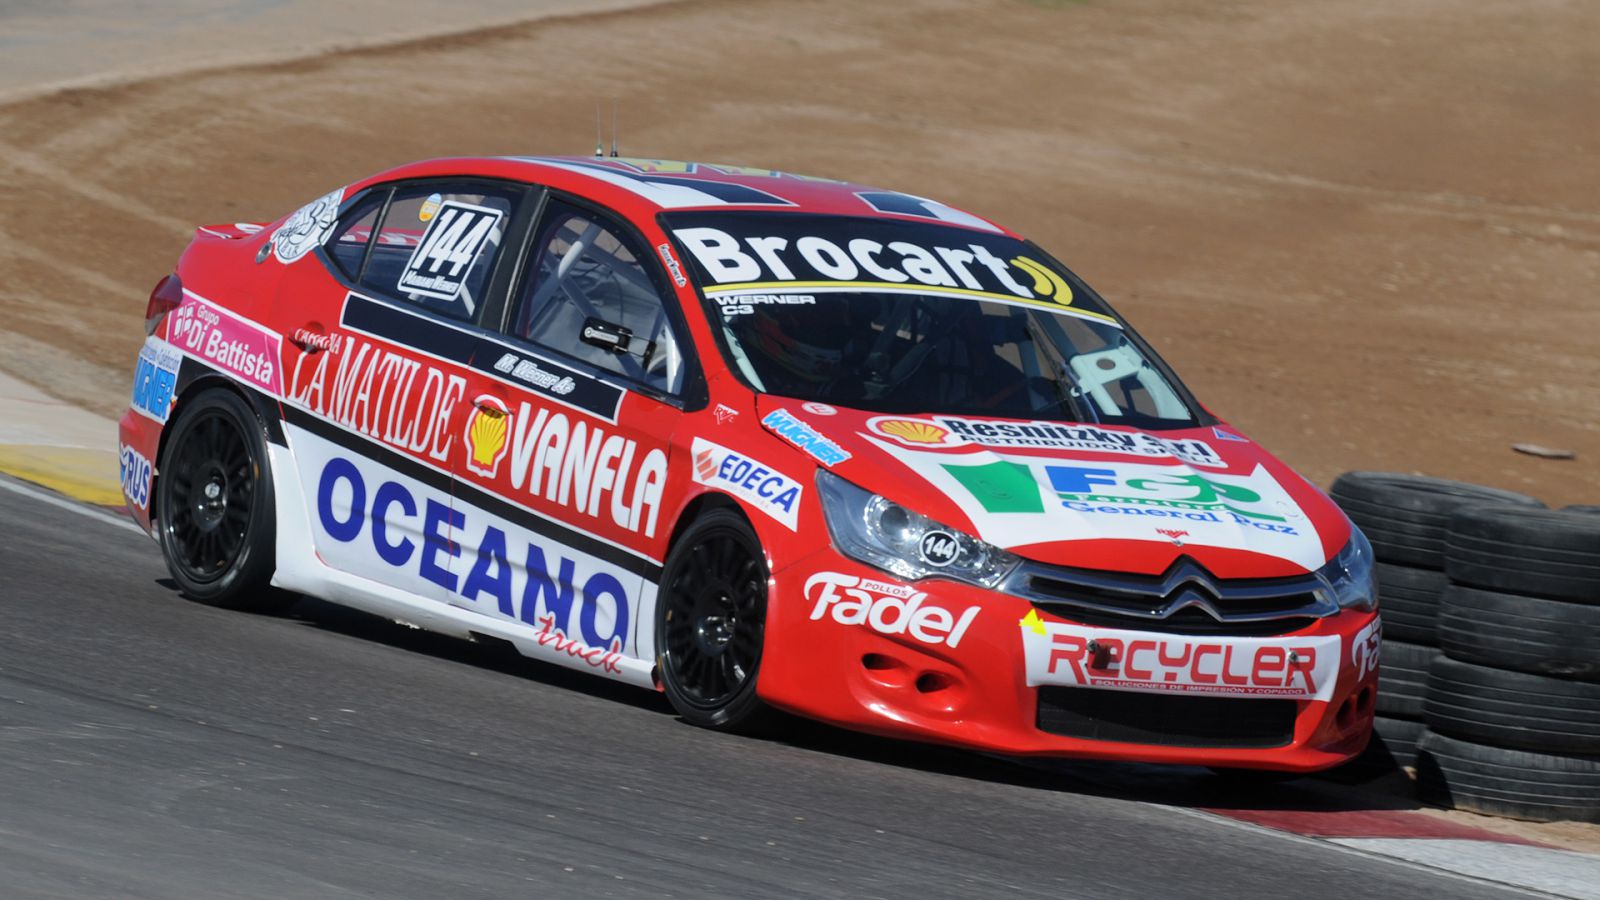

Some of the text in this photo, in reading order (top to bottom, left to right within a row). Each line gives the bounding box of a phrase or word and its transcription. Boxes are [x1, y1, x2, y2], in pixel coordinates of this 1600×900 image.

[411, 208, 495, 277] 144
[672, 227, 1035, 299] Brocart
[197, 304, 220, 326] Grupo
[714, 294, 816, 305] WERNER
[721, 305, 754, 315] C3
[186, 319, 209, 352] Di
[204, 329, 274, 385] Battista
[287, 335, 467, 463] LA MATILDE
[942, 418, 1136, 447] Resnitzky
[960, 434, 1134, 453] DISTRIBUIDOR
[126, 453, 151, 508] RUS
[510, 400, 669, 538] VANFLA
[718, 454, 799, 513] EDECA
[1061, 500, 1299, 536] General Paz
[317, 456, 629, 655] OCEANO
[924, 535, 955, 560] 144
[803, 570, 982, 649] Fadel
[864, 581, 909, 598] POLLOS
[534, 615, 622, 675] truck
[1095, 679, 1167, 690] SOLUCIONES
[1169, 683, 1185, 691] DE
